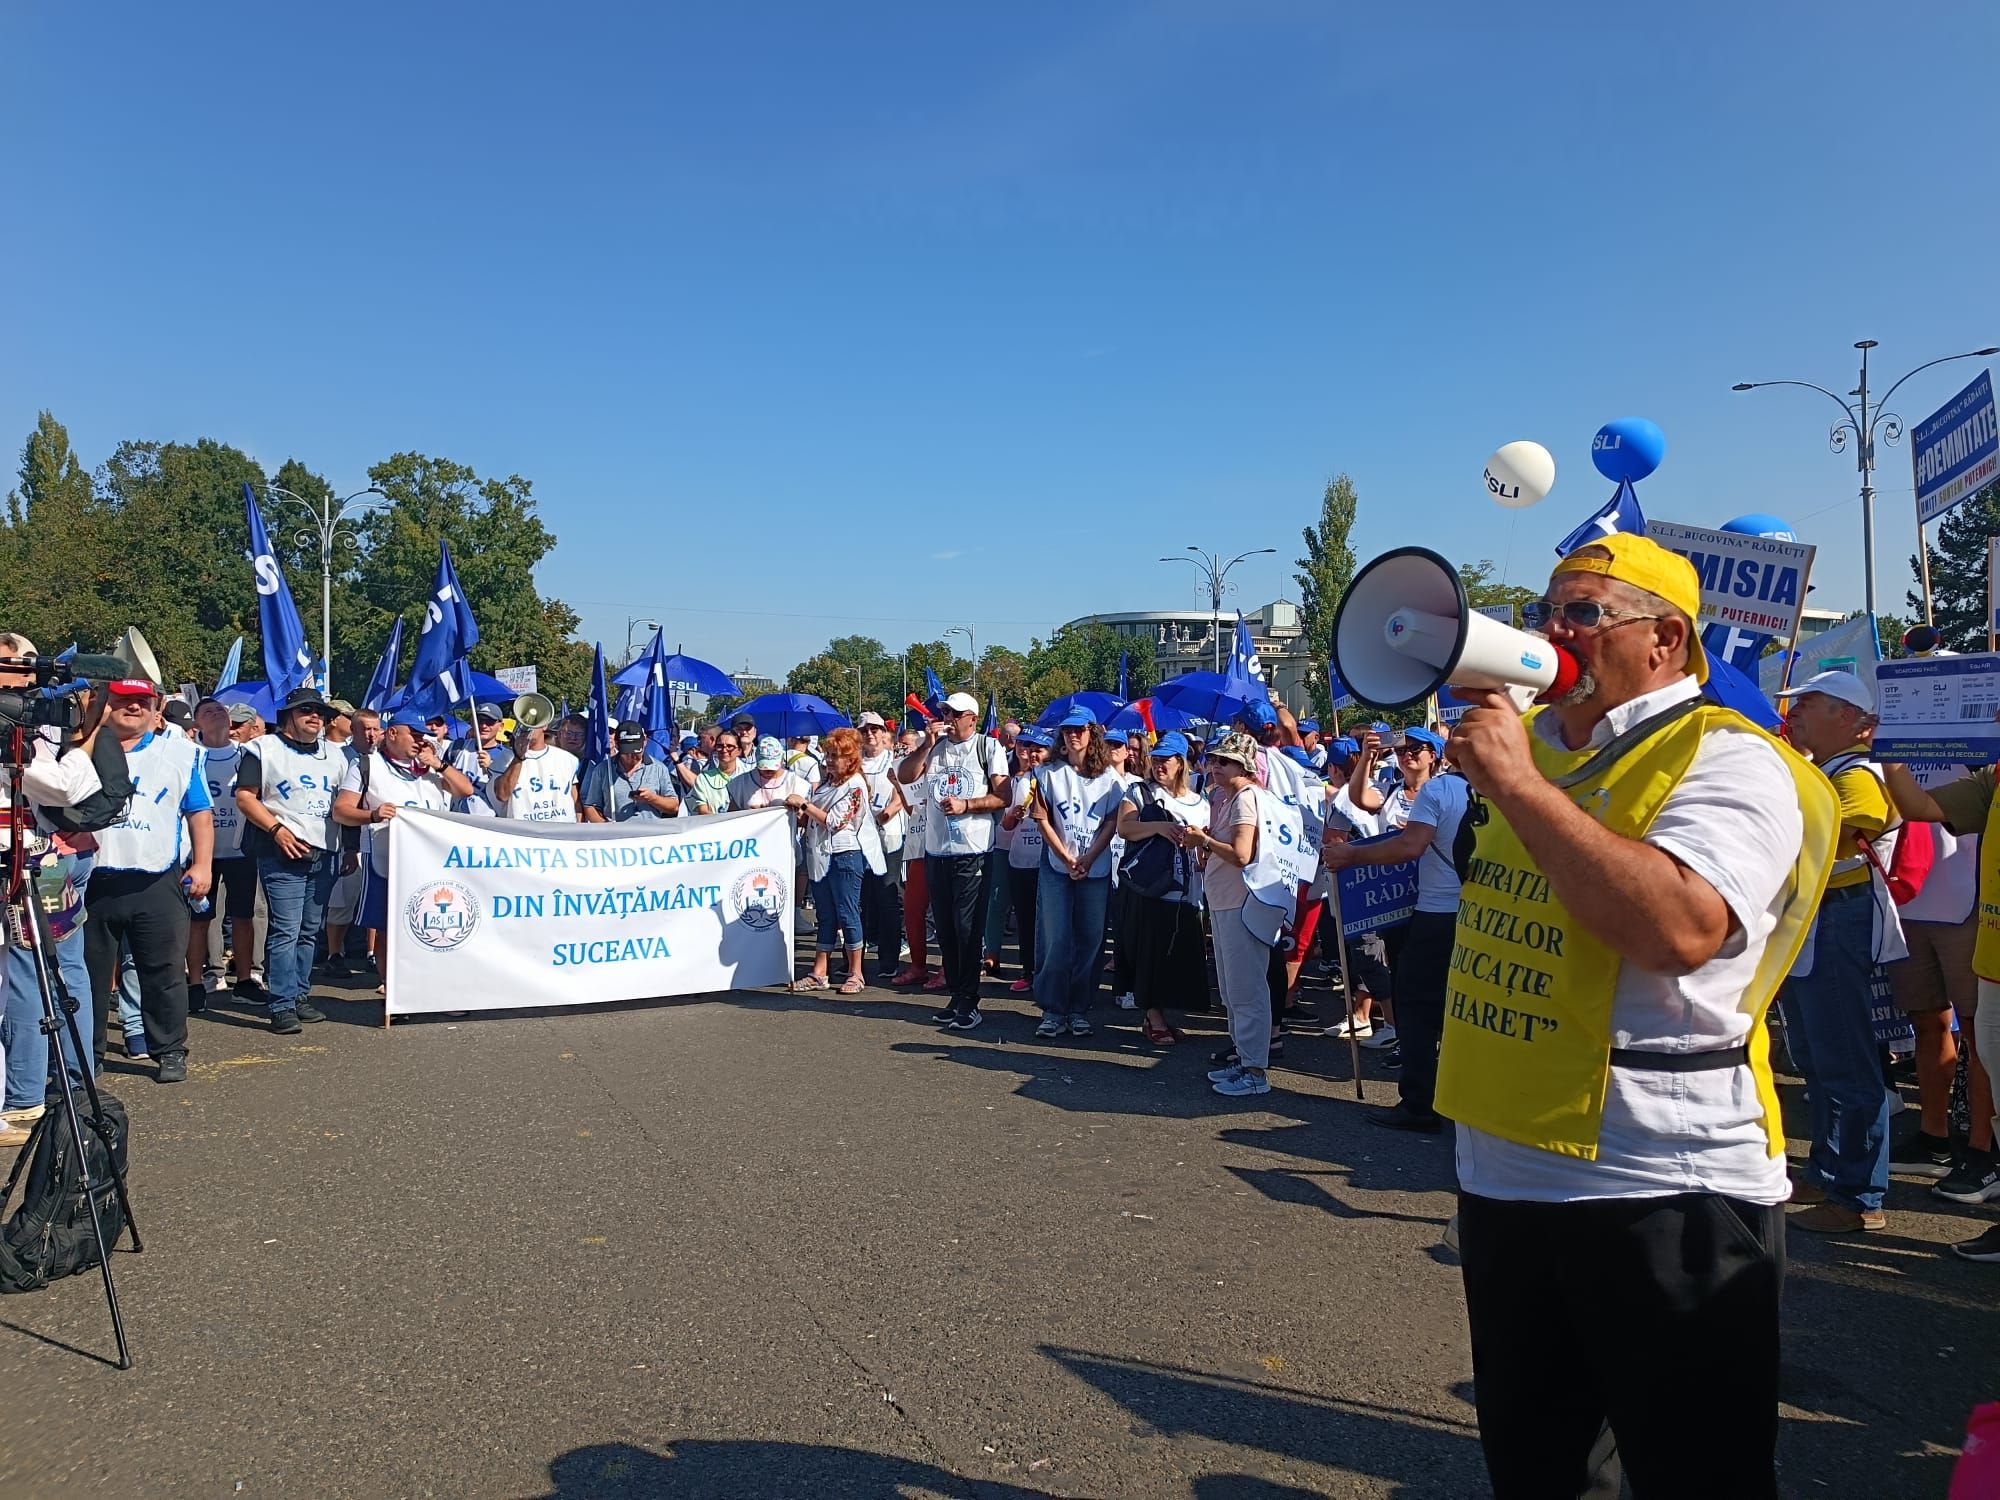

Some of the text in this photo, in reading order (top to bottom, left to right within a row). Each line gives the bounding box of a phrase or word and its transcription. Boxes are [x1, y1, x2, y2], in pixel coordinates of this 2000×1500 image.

[1917, 401, 1998, 488] #DEMNITATE
[1920, 495, 1938, 515] UNIȚI
[1939, 478, 1963, 504] SUNTEM
[1751, 541, 1806, 559] RĂDĂUȚI
[1672, 548, 1798, 606] MISIA
[1721, 606, 1789, 631] PUTERNICI!
[668, 680, 698, 692] FSLI
[443, 837, 760, 873] ALIANȚA SINDICATELOR
[492, 884, 721, 920] DIN ÎNVĂȚĂMÂNT
[552, 936, 671, 966] SUCEAVA
